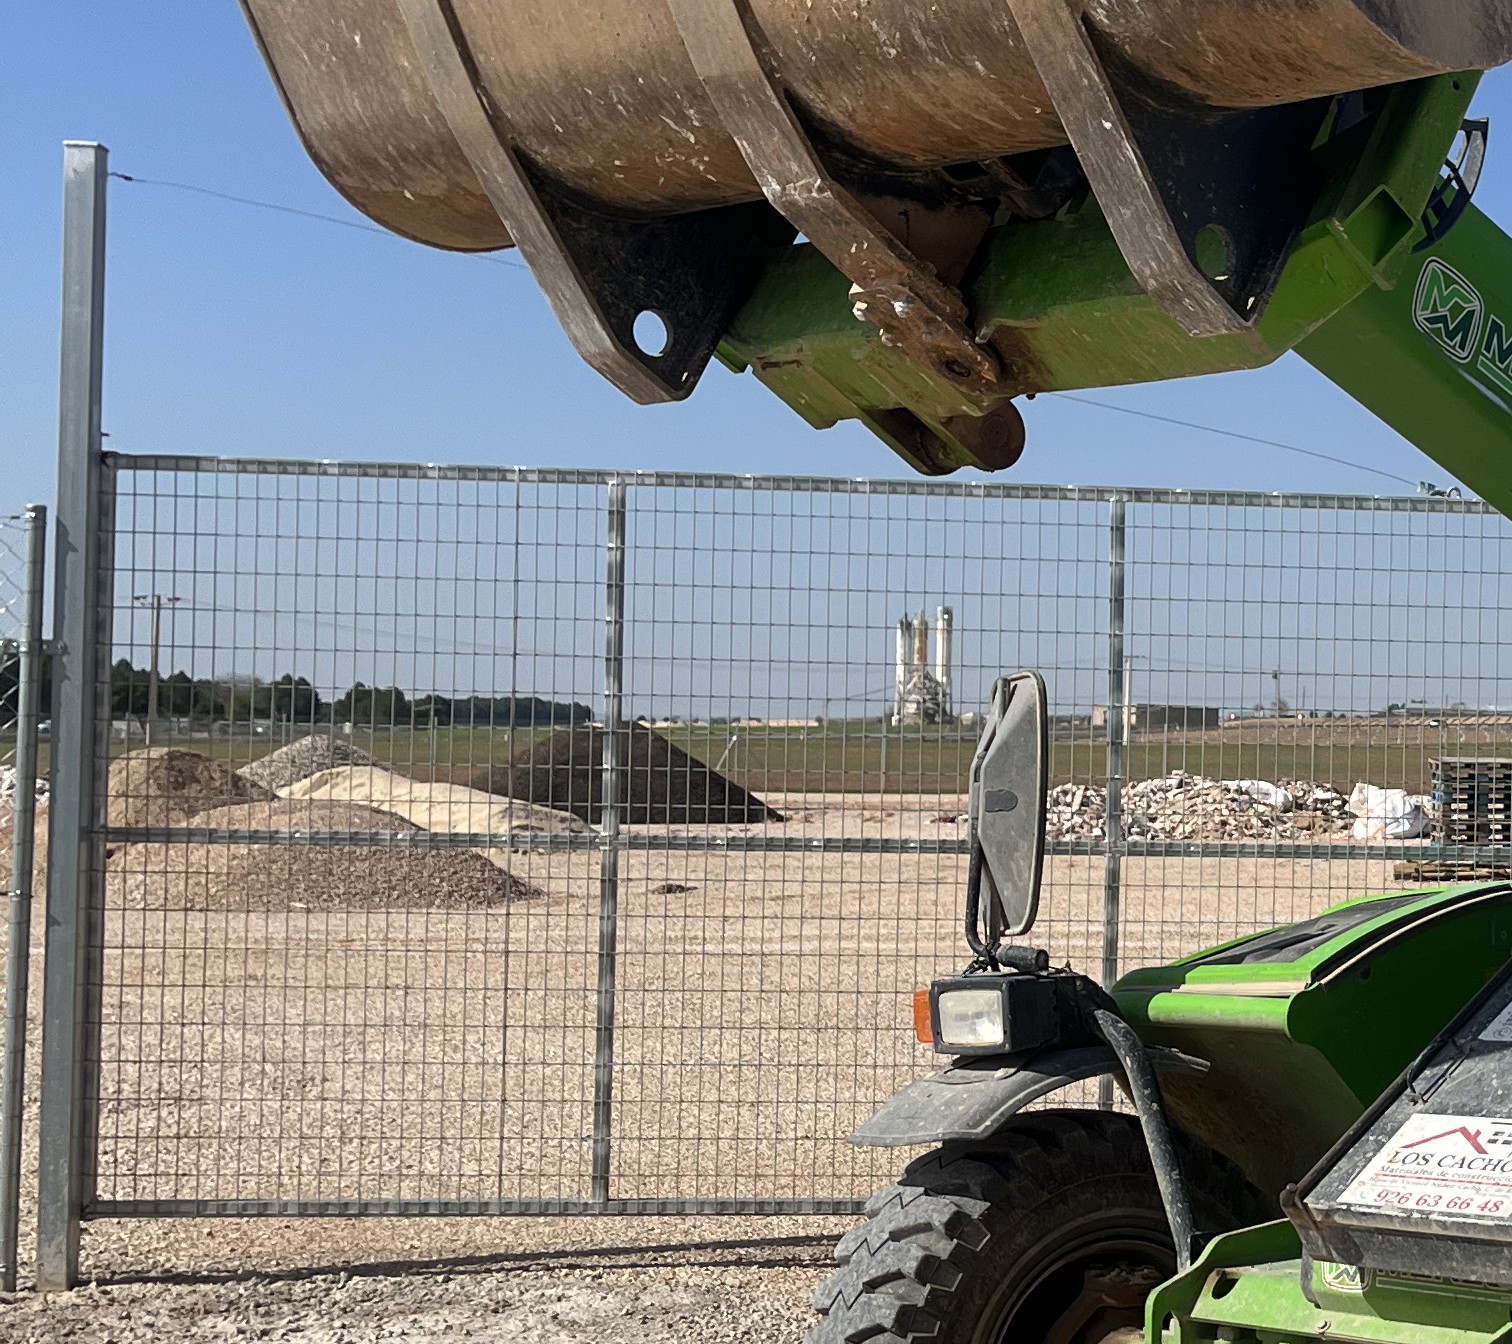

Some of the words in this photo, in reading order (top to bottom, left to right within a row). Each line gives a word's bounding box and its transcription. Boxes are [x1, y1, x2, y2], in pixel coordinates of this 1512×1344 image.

[1387, 1151, 1435, 1165] LOS
[1378, 1165, 1435, 1175] Materiales
[1437, 1169, 1450, 1177] de
[1372, 1190, 1414, 1204] 926
[1414, 1194, 1444, 1206] 63
[1445, 1197, 1475, 1209] 66
[1475, 1199, 1505, 1212] 48
